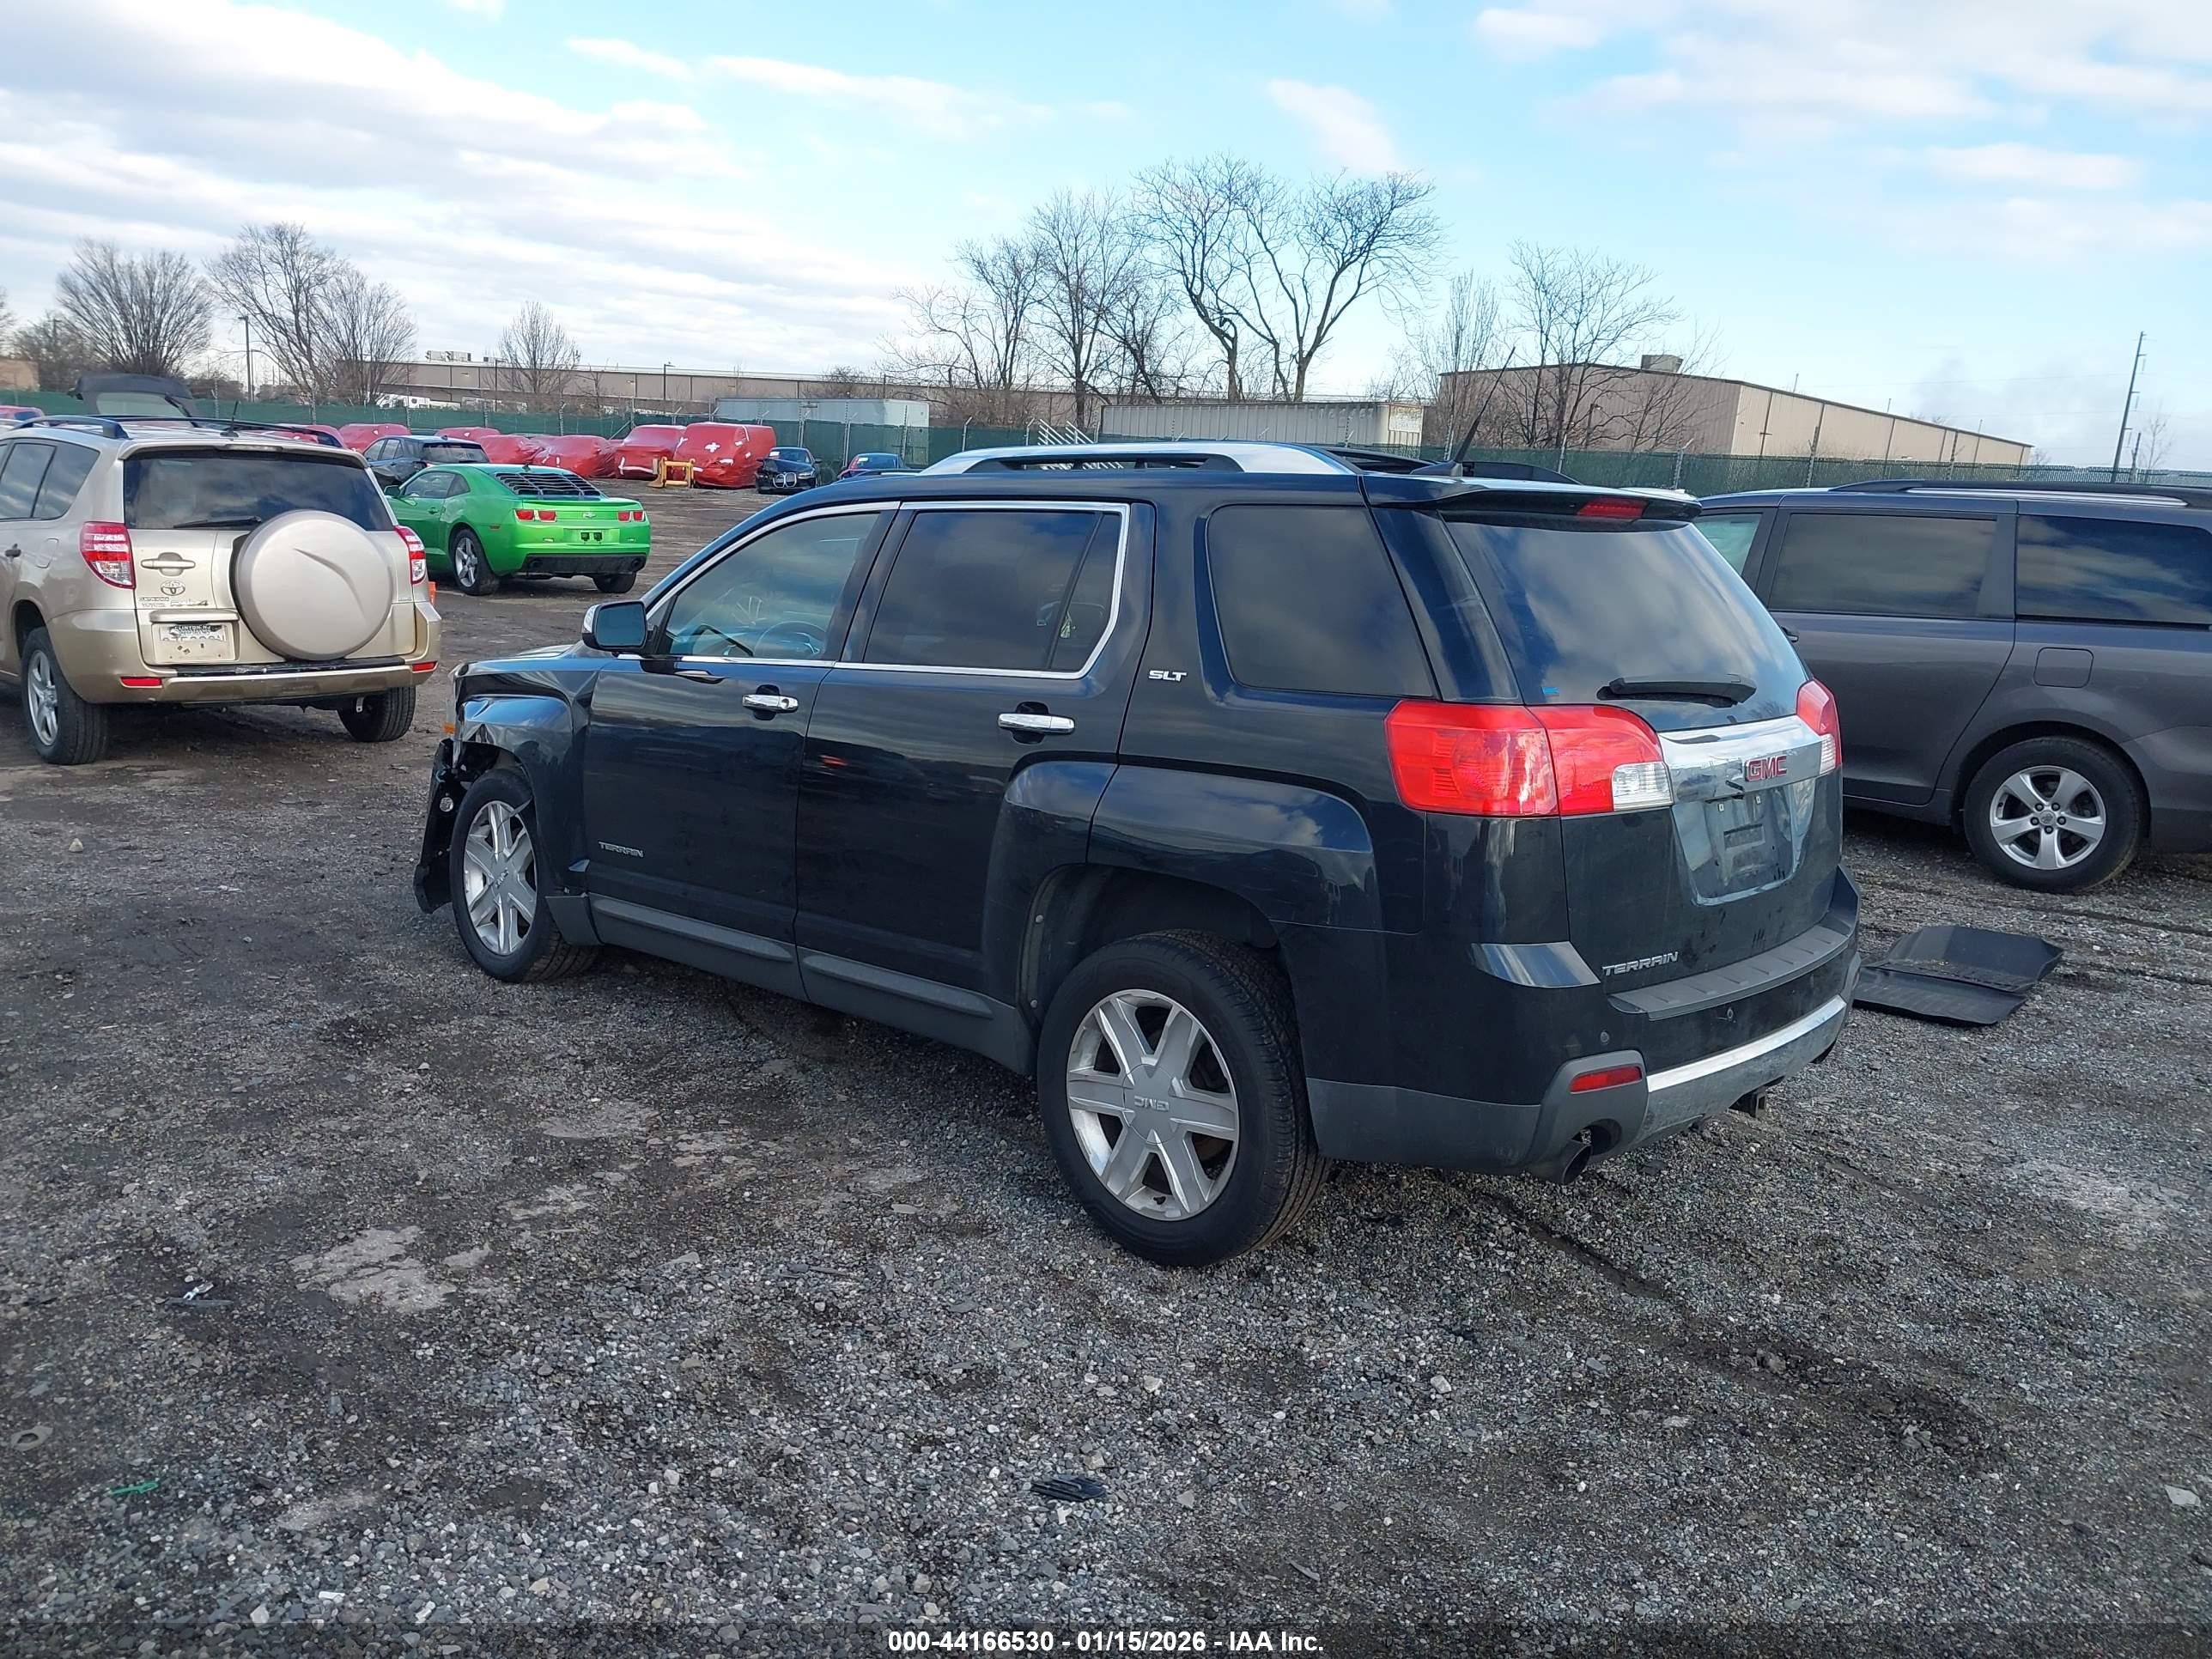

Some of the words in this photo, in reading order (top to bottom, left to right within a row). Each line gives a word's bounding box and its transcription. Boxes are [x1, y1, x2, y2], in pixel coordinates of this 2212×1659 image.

[1148, 670, 1188, 682] SLT
[1745, 755, 1788, 782] GMC
[598, 841, 645, 858] TERRAIN
[1601, 951, 1679, 976] TERRAIN
[1133, 1095, 1170, 1112] GMC
